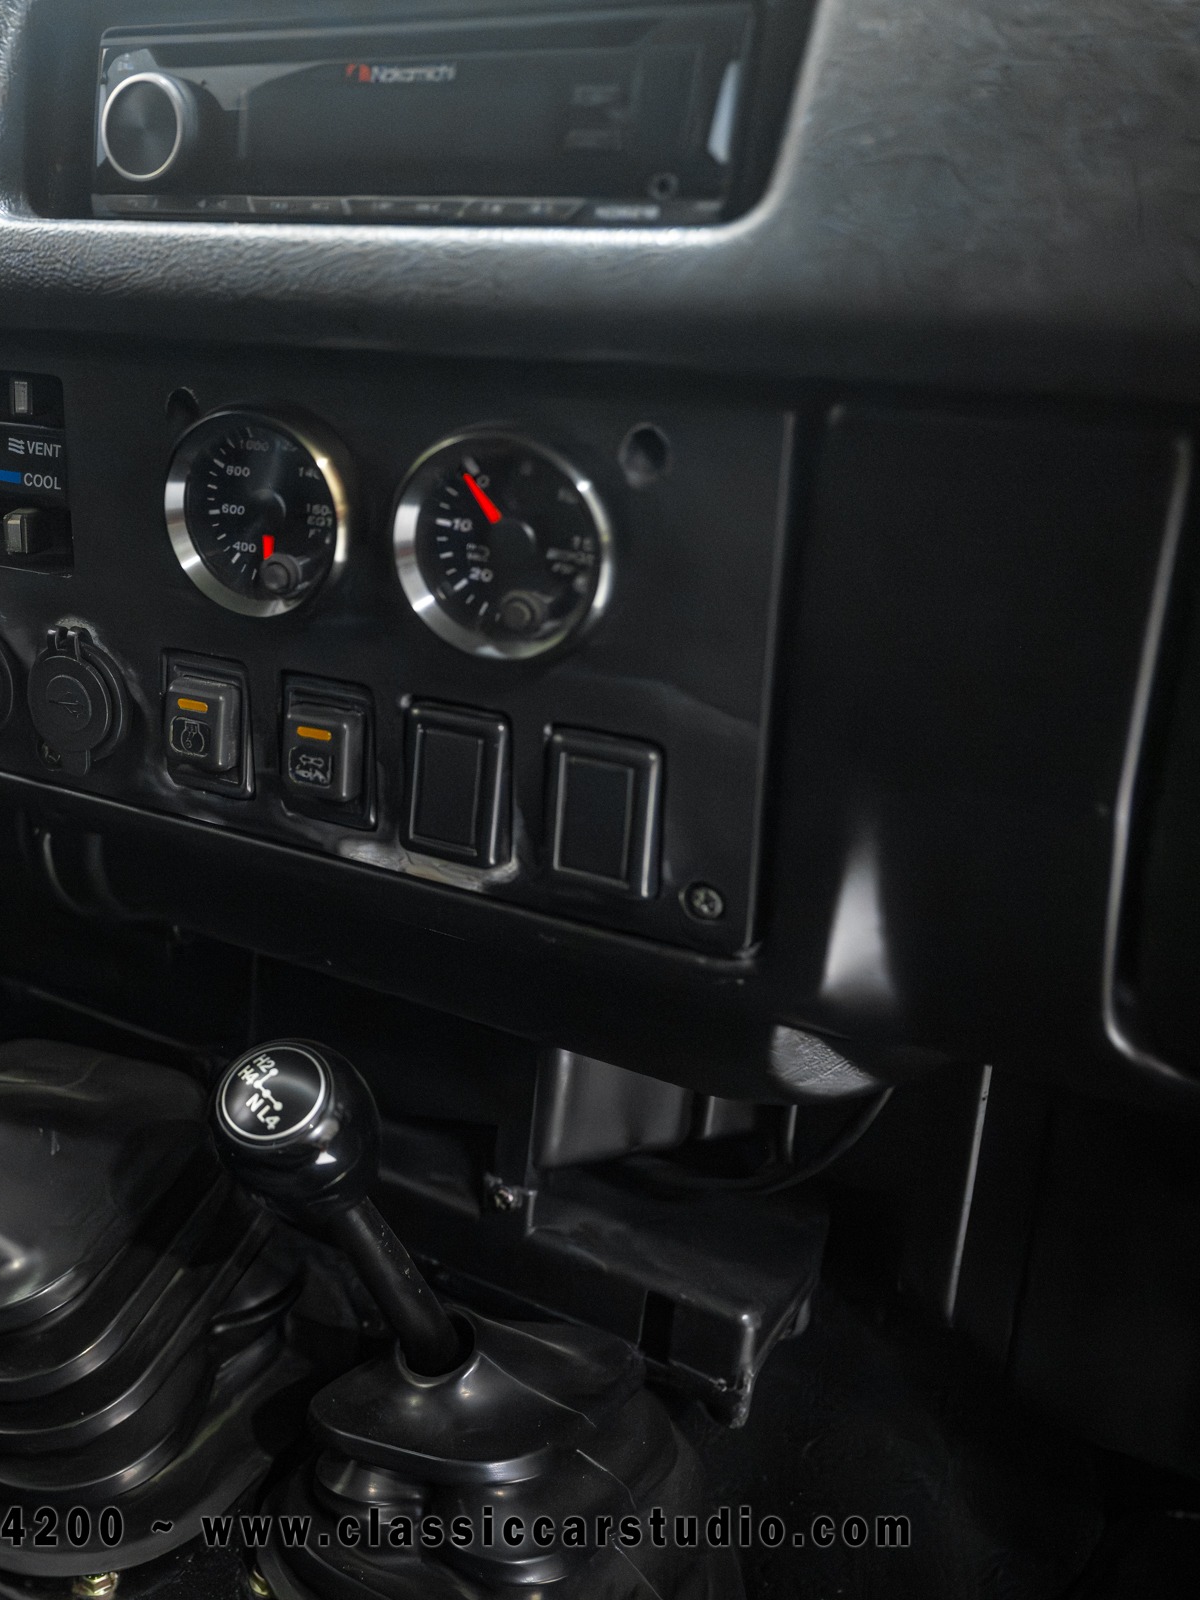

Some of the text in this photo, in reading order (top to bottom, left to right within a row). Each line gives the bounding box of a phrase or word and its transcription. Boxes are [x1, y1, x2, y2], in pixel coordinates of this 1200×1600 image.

[26, 440, 61, 458] VENT
[226, 465, 250, 478] 800
[23, 473, 62, 491] COOL
[221, 504, 245, 516] 600
[452, 517, 473, 533] 10
[232, 541, 257, 553] 400
[468, 566, 494, 583] 20
[253, 1053, 276, 1073] H2
[238, 1066, 259, 1084] H4
[246, 1093, 264, 1112] N
[256, 1105, 281, 1130] L4
